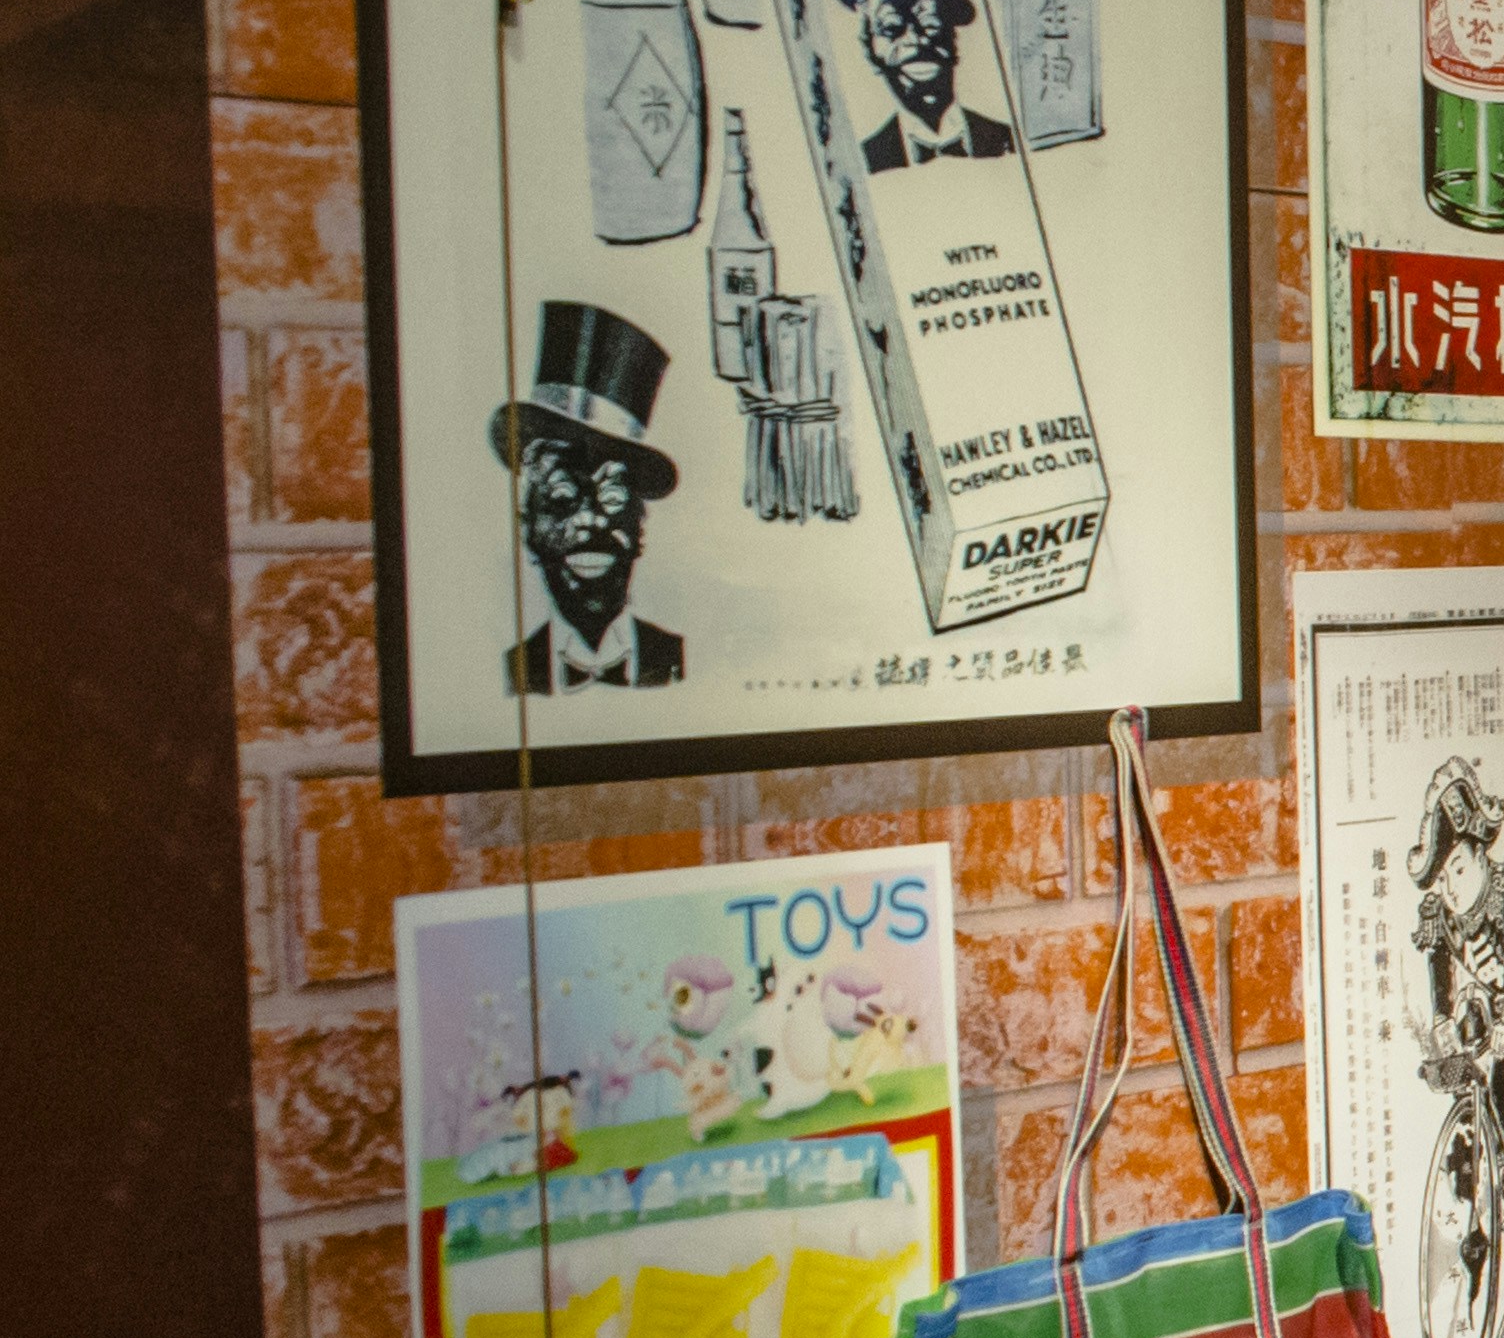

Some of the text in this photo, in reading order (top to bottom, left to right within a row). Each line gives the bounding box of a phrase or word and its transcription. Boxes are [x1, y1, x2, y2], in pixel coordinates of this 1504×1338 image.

[944, 244, 998, 265] WITH
[910, 271, 1043, 308] MONOFLUORO
[918, 299, 1051, 337] PHOSPHATE
[938, 415, 1091, 469] HAWLEY & HAZEL
[948, 461, 1031, 496] CHEMICAL
[962, 513, 1099, 570] DARKIE
[988, 550, 1062, 581] SUPER
[724, 875, 930, 968] TOYS
